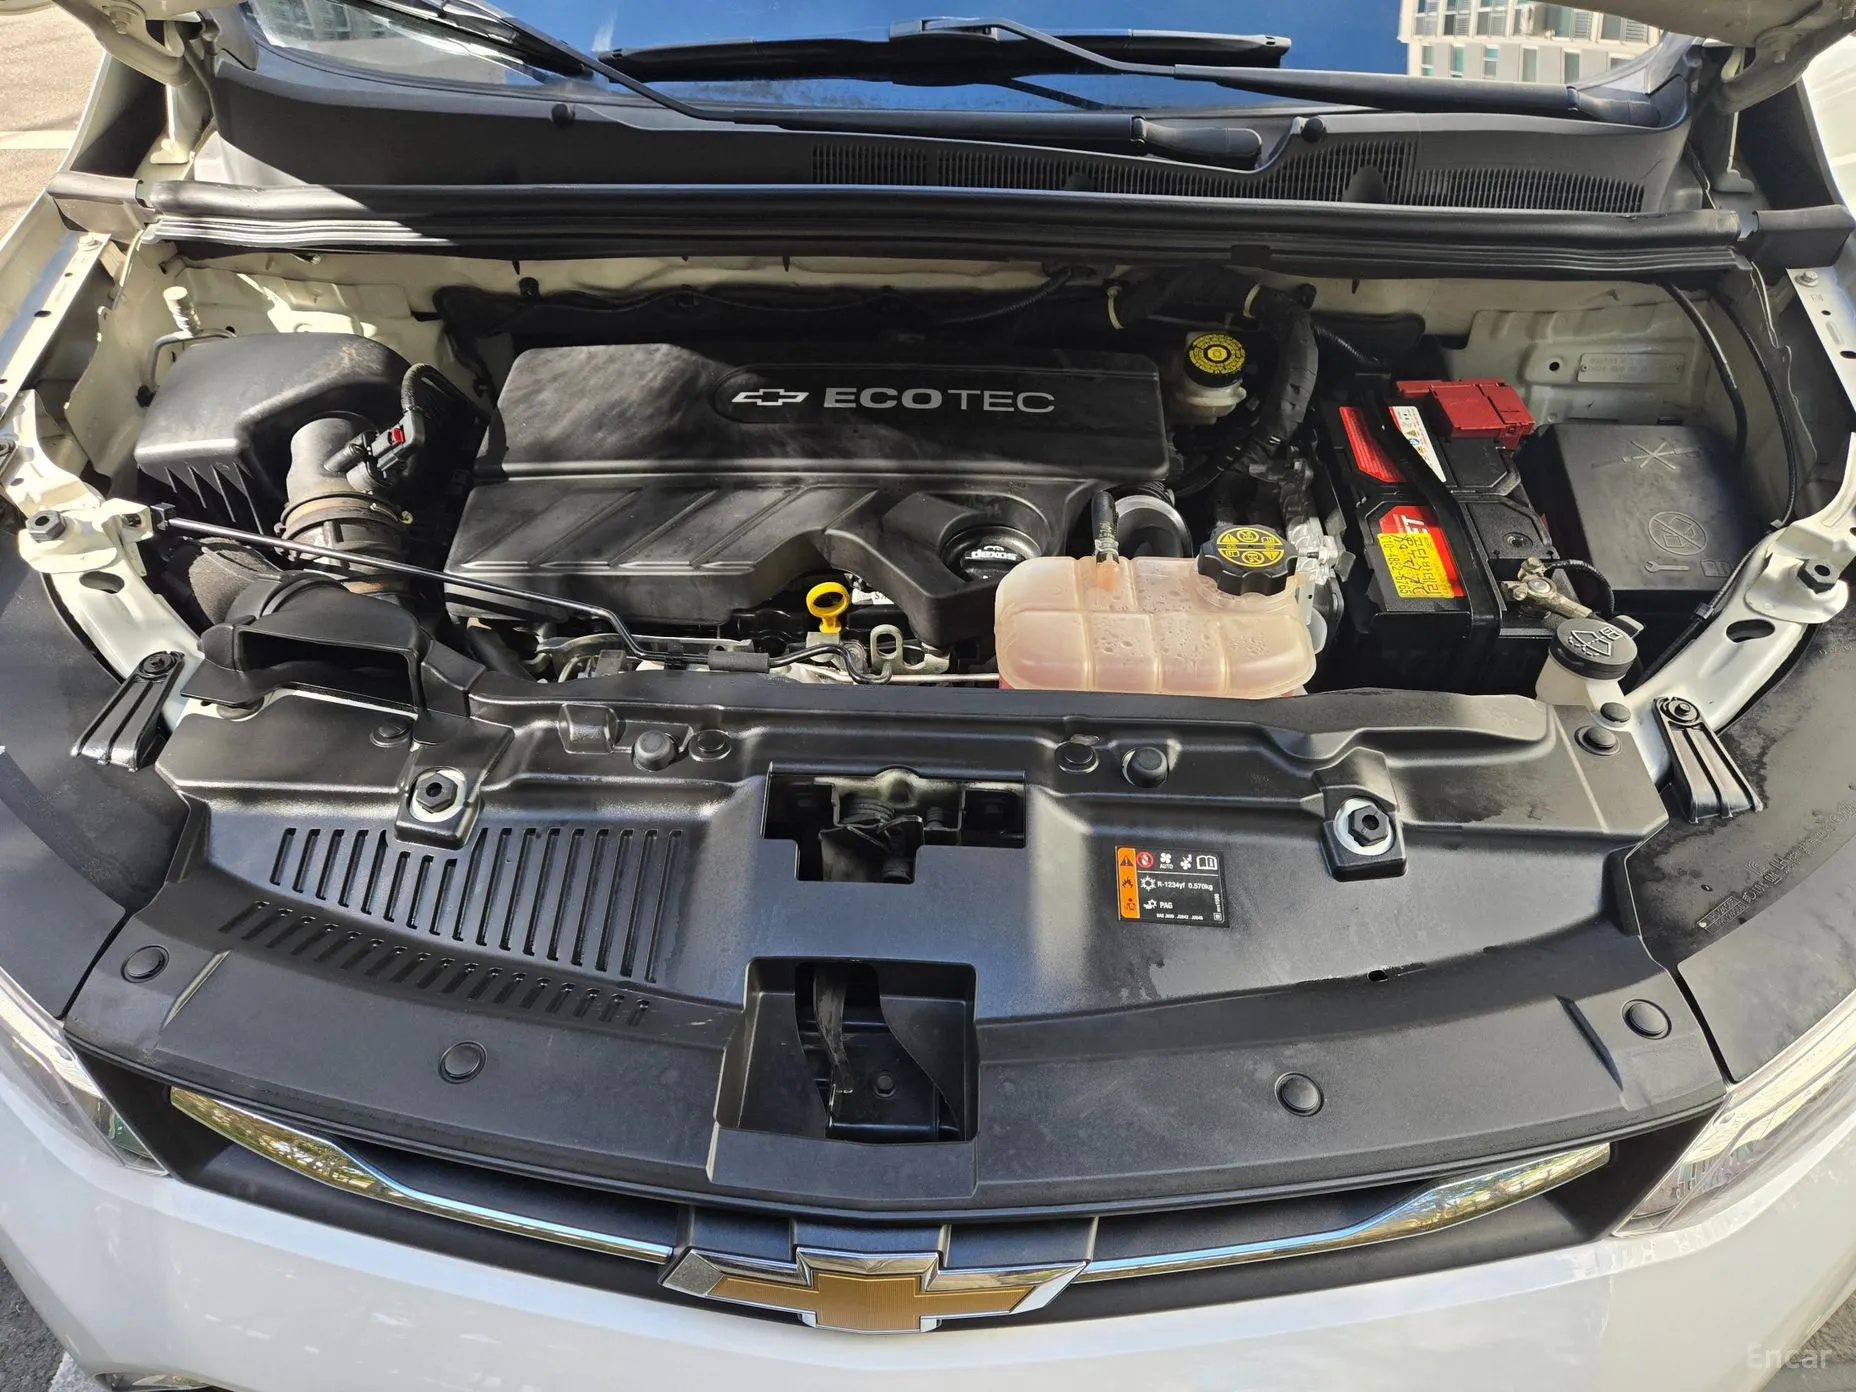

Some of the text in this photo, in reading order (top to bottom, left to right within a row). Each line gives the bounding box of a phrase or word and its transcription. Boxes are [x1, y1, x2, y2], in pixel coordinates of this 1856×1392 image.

[824, 387, 1055, 413] ECOTEC
[971, 549, 1017, 561] dexos
[1157, 881, 1214, 892] R-1234yf 0.570kg
